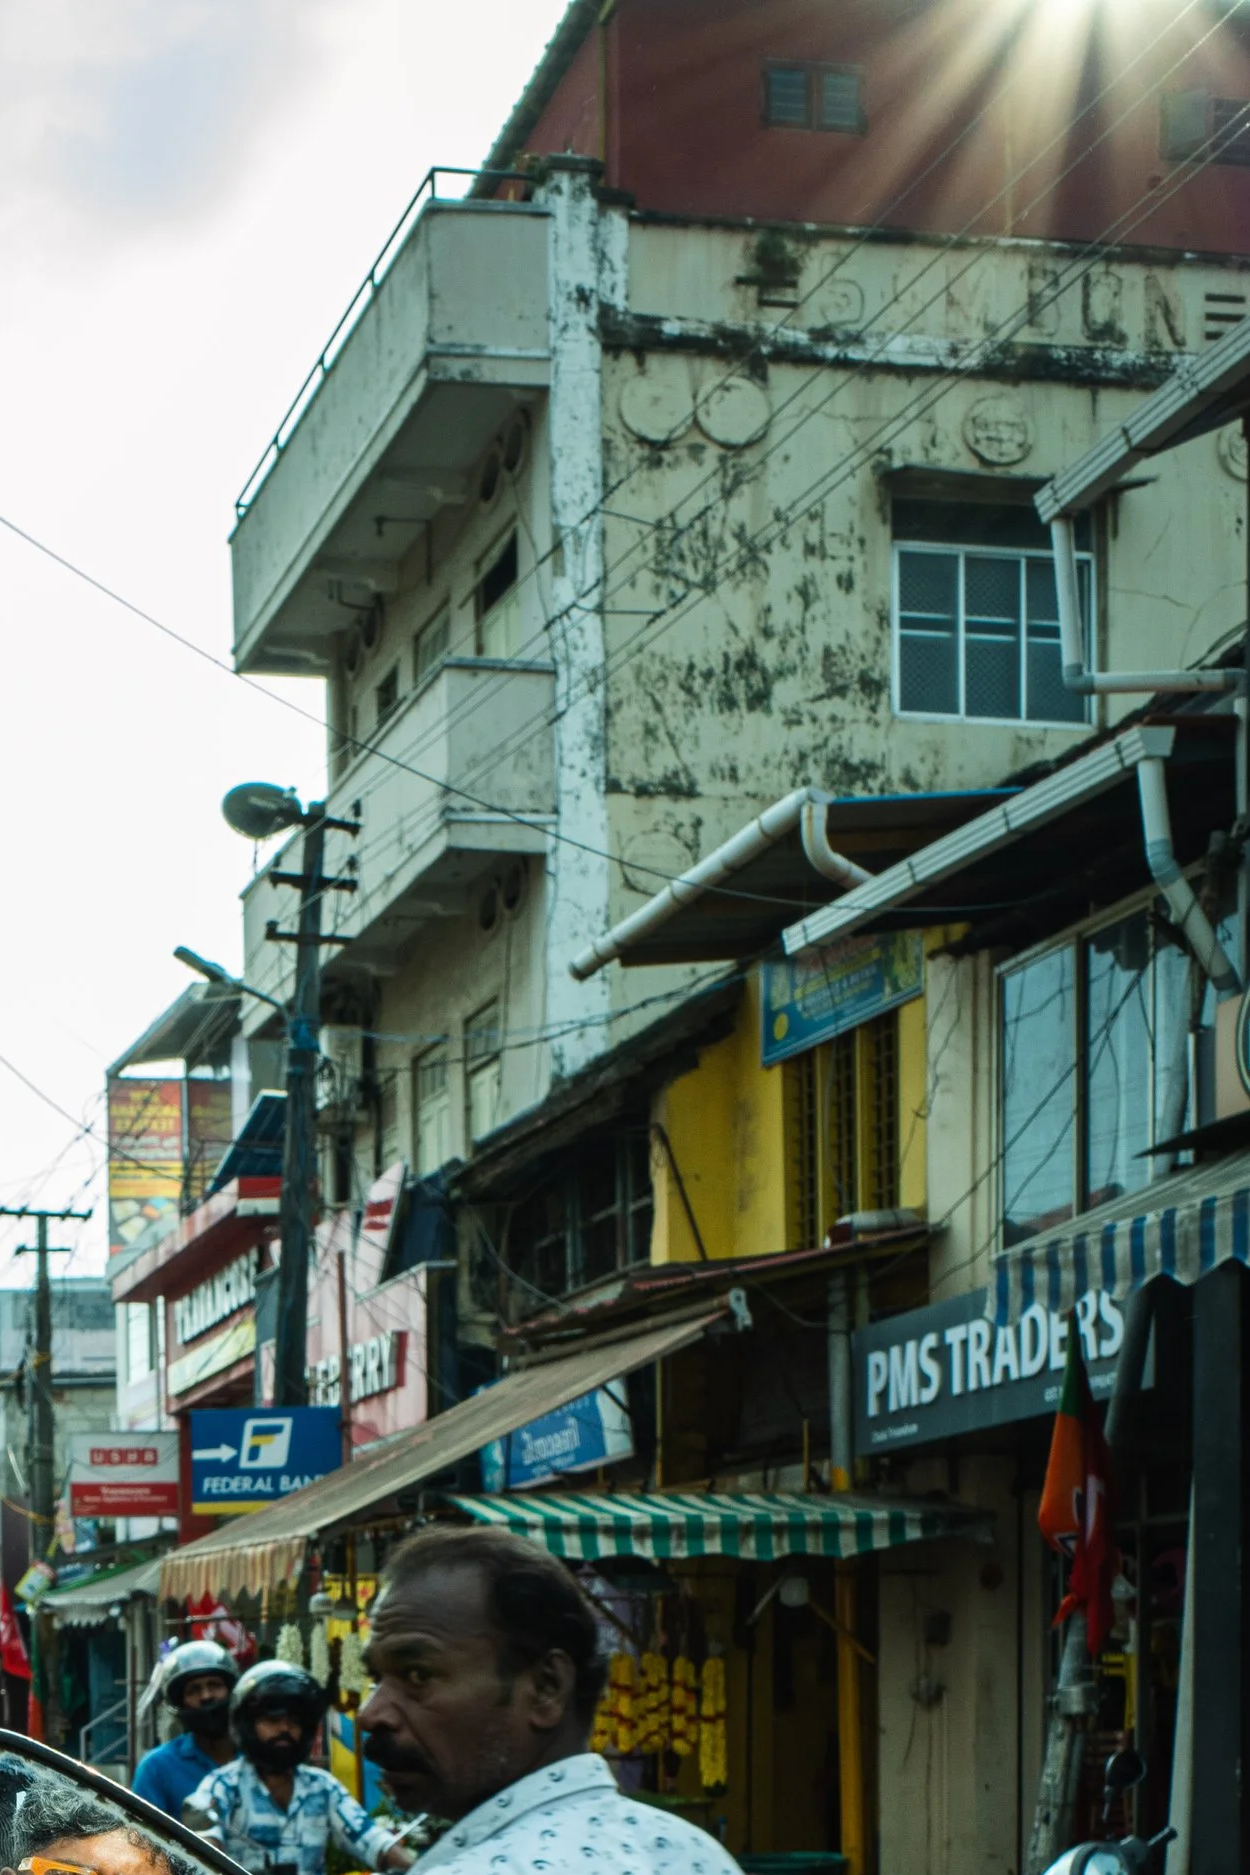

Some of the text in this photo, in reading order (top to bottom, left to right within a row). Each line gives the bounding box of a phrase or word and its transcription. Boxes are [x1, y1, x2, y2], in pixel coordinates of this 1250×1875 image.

[867, 1289, 1125, 1417] PMS TRADERS
[202, 1473, 326, 1495] FEDERAL BAN
